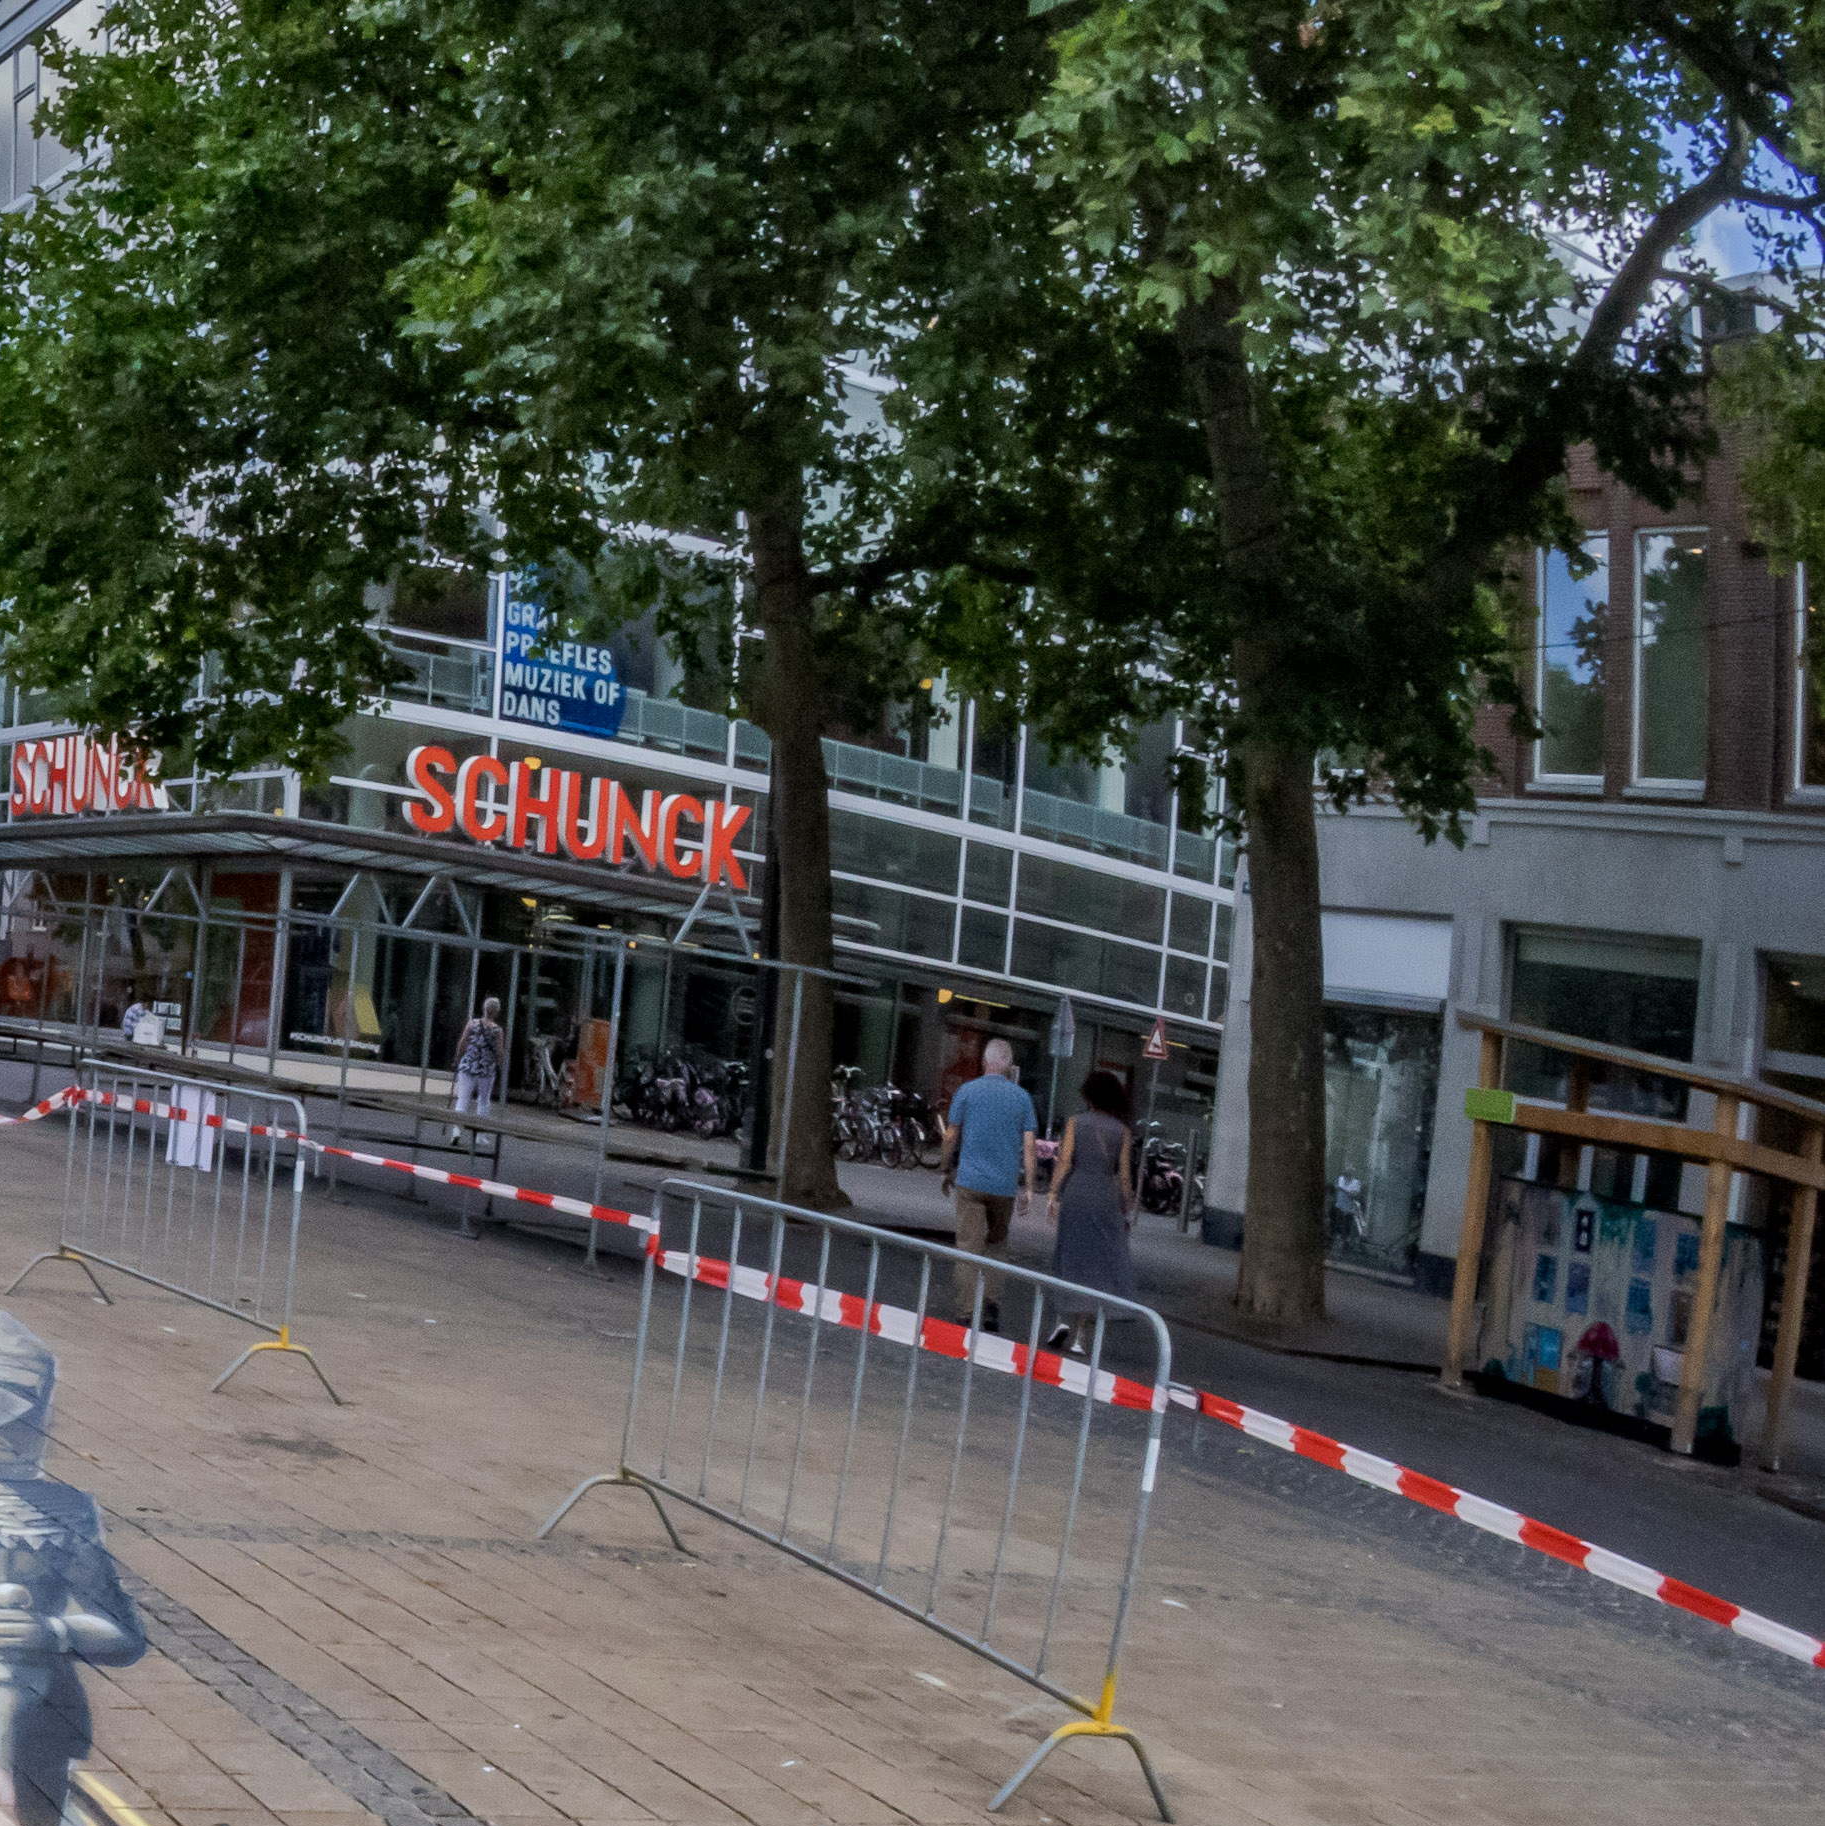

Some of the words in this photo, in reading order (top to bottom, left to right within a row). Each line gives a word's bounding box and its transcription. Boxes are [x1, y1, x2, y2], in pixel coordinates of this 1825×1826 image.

[505, 661, 586, 700] MUZIEK
[594, 678, 621, 706] OF
[502, 691, 561, 725] DANS
[402, 745, 752, 889] SCHUNCK
